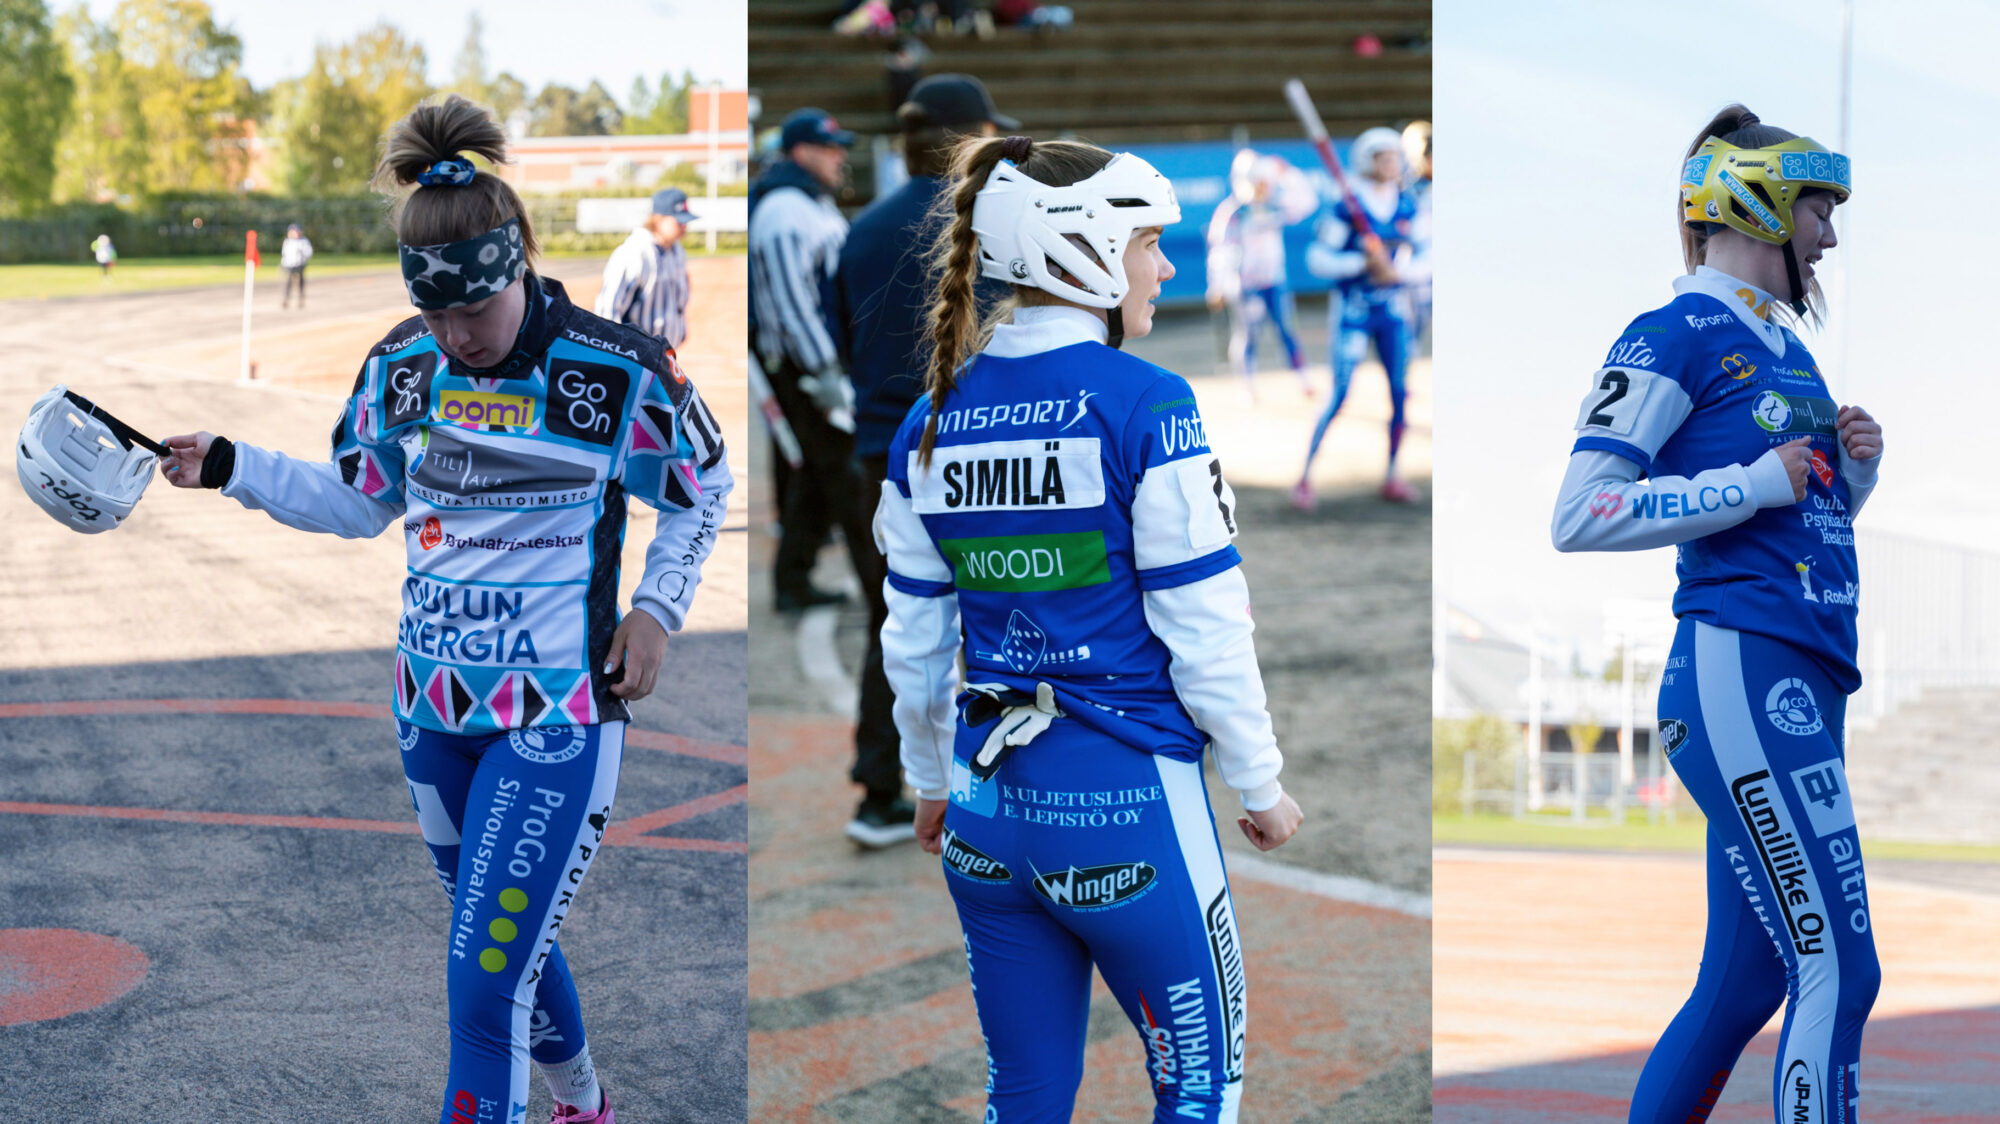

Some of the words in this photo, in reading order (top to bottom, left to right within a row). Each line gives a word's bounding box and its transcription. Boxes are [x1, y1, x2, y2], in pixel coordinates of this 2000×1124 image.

[1784, 155, 1802, 166] Go
[1789, 165, 1806, 176] On
[1810, 154, 1828, 166] Go
[1815, 166, 1831, 178] On
[1724, 174, 1775, 225] WWW.GO-ON.FI
[566, 328, 638, 361] TACKLA
[391, 367, 422, 395] Go
[558, 370, 607, 403] Go
[395, 390, 422, 415] On
[443, 398, 531, 425] oomi
[1585, 370, 1630, 427] 2
[568, 400, 611, 434] On
[433, 452, 464, 472] TILI
[942, 441, 1066, 508] SIMILÄ
[470, 490, 588, 506] TILITOIMISTO
[1632, 484, 1745, 519] WELCO
[962, 547, 1065, 580] WOODI
[406, 577, 523, 623] OULUN
[1774, 717, 1816, 733] CARBON
[510, 733, 547, 762] CARBON
[552, 743, 582, 762] WISE
[1004, 803, 1019, 819] E.
[1024, 807, 1107, 828] LEPISTÖ
[1113, 808, 1144, 826] OY
[508, 787, 566, 878] ProGo
[452, 777, 521, 961] Siivouspalvelut
[1731, 769, 1811, 908] Lumiliike
[1794, 912, 1825, 956] Oy
[1026, 856, 1146, 905] Winger
[1829, 838, 1869, 935] altro
[527, 844, 592, 985] PUKKILA
[1206, 885, 1244, 1029] Lumiliike
[1794, 1076, 1811, 1124] JP-M
